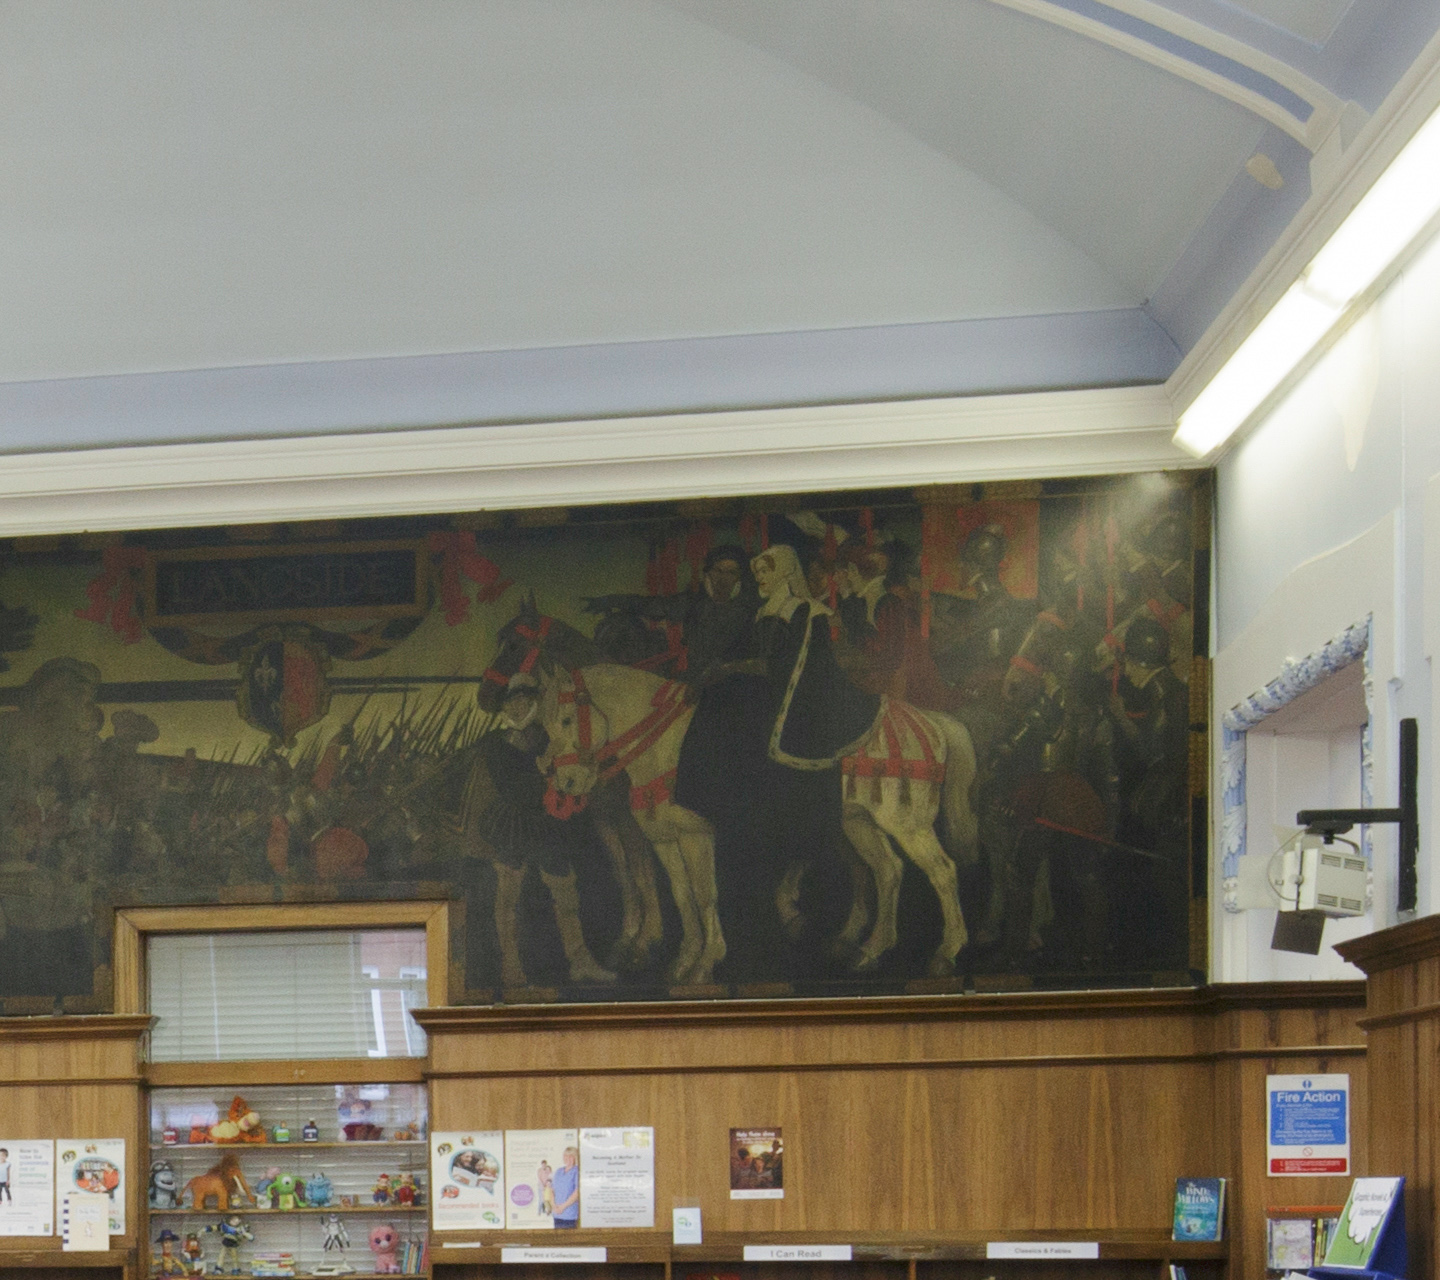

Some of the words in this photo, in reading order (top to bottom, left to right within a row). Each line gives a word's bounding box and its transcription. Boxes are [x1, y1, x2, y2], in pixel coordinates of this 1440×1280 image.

[1276, 1091, 1301, 1103] Fire
[1302, 1091, 1341, 1103] Action
[775, 1250, 795, 1258] Can
[797, 1250, 822, 1258] Read
